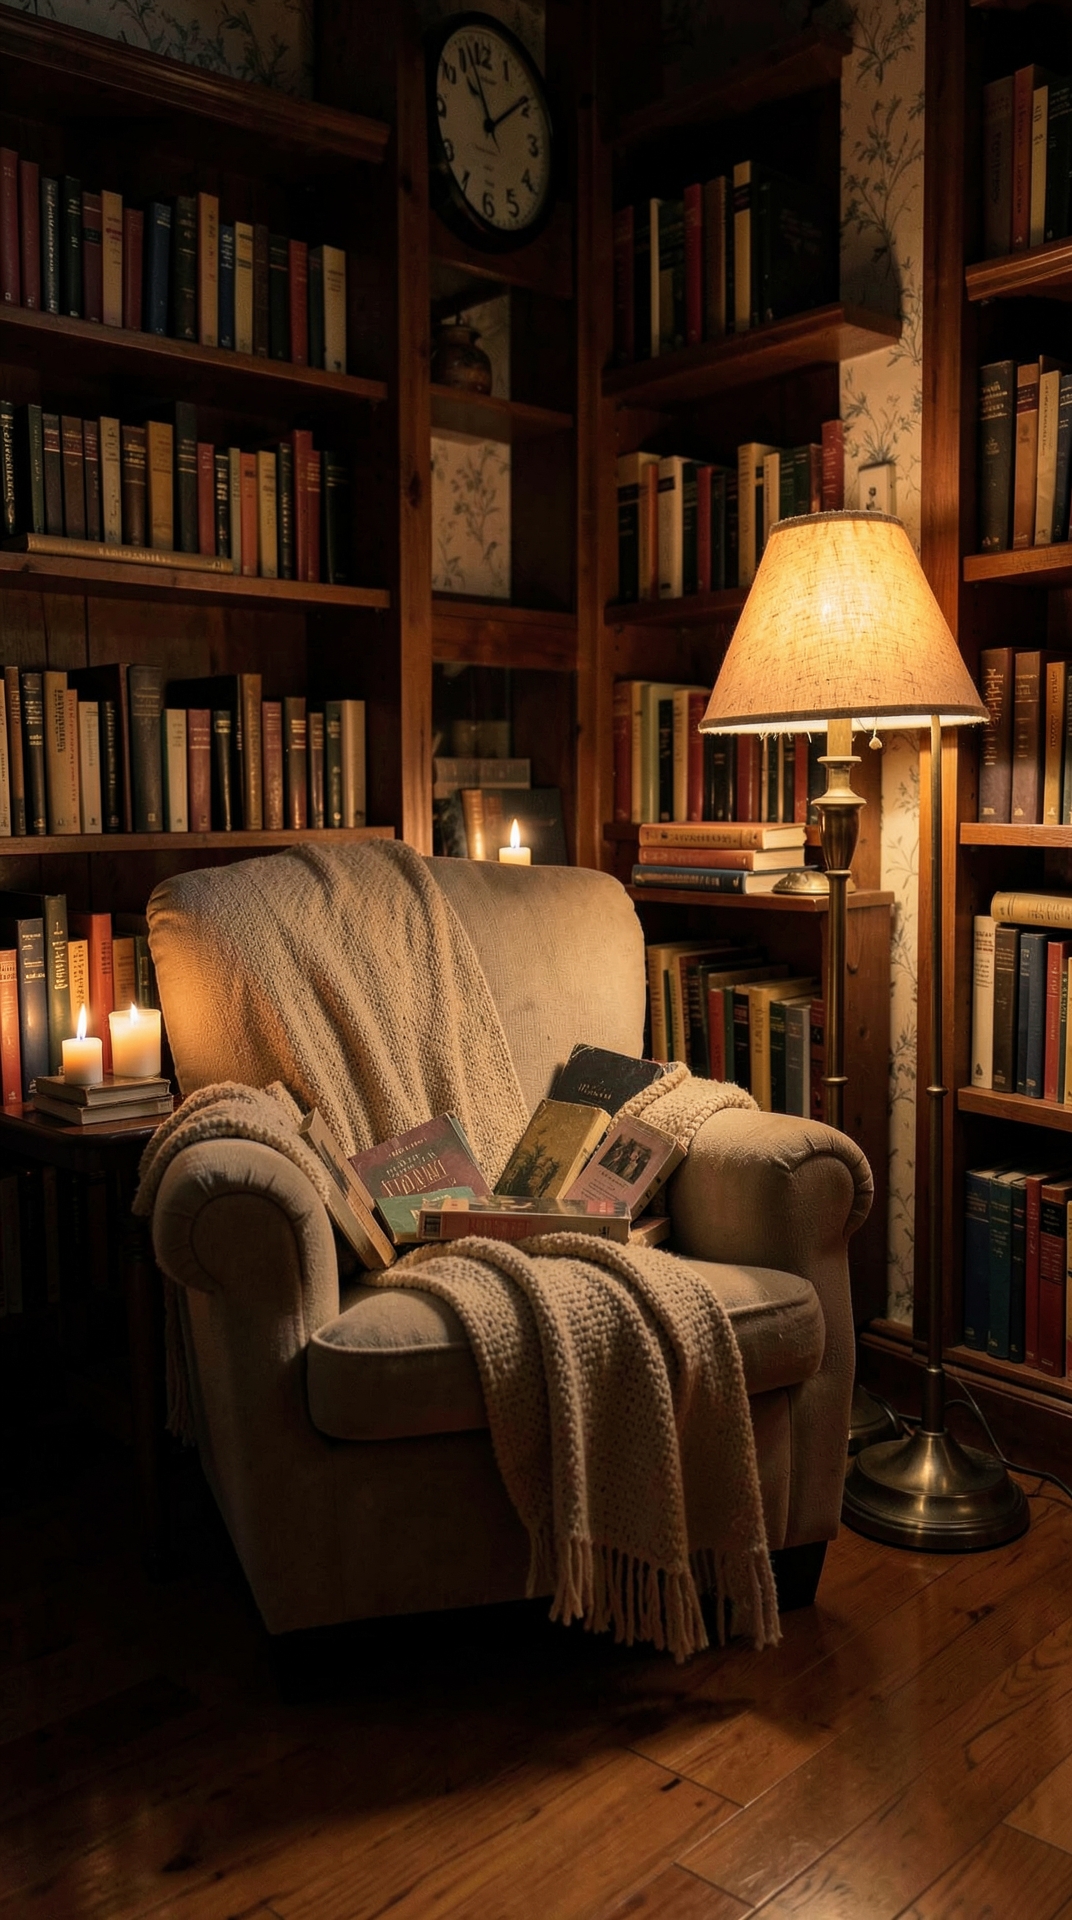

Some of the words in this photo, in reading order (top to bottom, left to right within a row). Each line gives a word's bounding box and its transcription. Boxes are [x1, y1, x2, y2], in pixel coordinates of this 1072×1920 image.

[474, 41, 493, 71] 12
[528, 134, 540, 158] 3
[521, 168, 538, 195] 4
[482, 191, 496, 219] 6
[506, 188, 520, 218] 5
